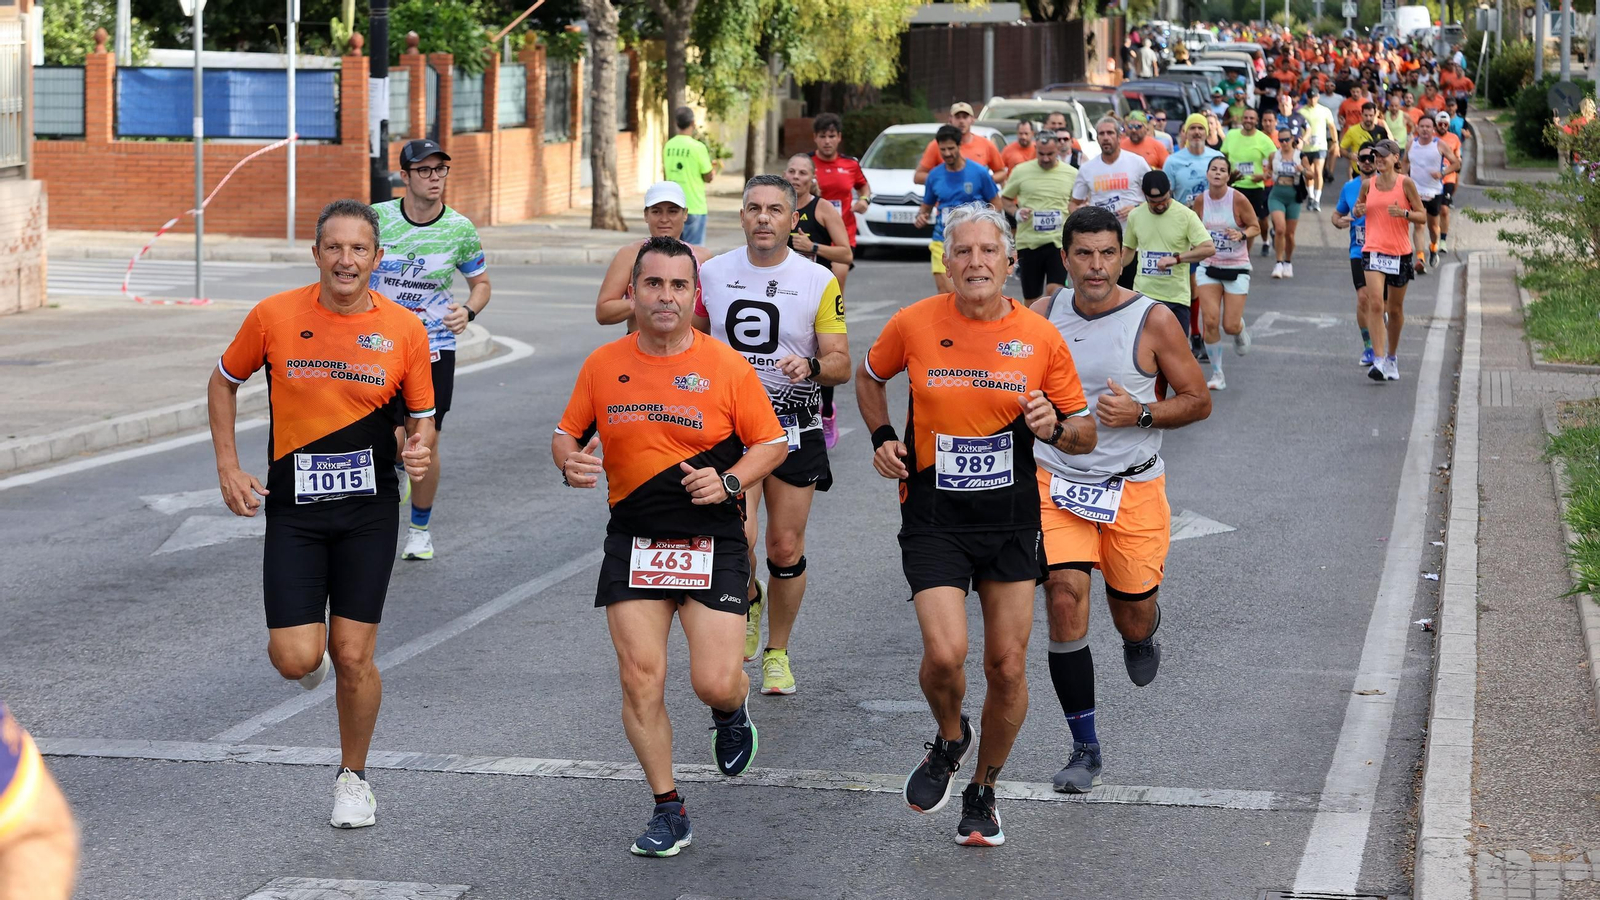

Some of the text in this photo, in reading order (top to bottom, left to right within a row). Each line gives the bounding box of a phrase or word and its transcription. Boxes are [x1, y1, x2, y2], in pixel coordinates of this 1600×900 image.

[1094, 177, 1129, 192] PUMA
[1040, 217, 1056, 225] 609
[1377, 259, 1393, 267] 959
[384, 277, 438, 290] VETE-RUNNERS
[396, 292, 423, 302] JEREZ
[286, 360, 347, 370] RODADORES
[330, 370, 385, 386] COBARDES
[928, 369, 988, 378] RODADORES
[972, 379, 1026, 393] COBARDES
[607, 404, 664, 414] RODADORES
[647, 413, 703, 430] COBARDES
[955, 454, 996, 473] 989
[308, 470, 363, 491] 1015
[1066, 485, 1104, 505] 657
[650, 551, 693, 571] 463
[728, 596, 741, 604] asics
